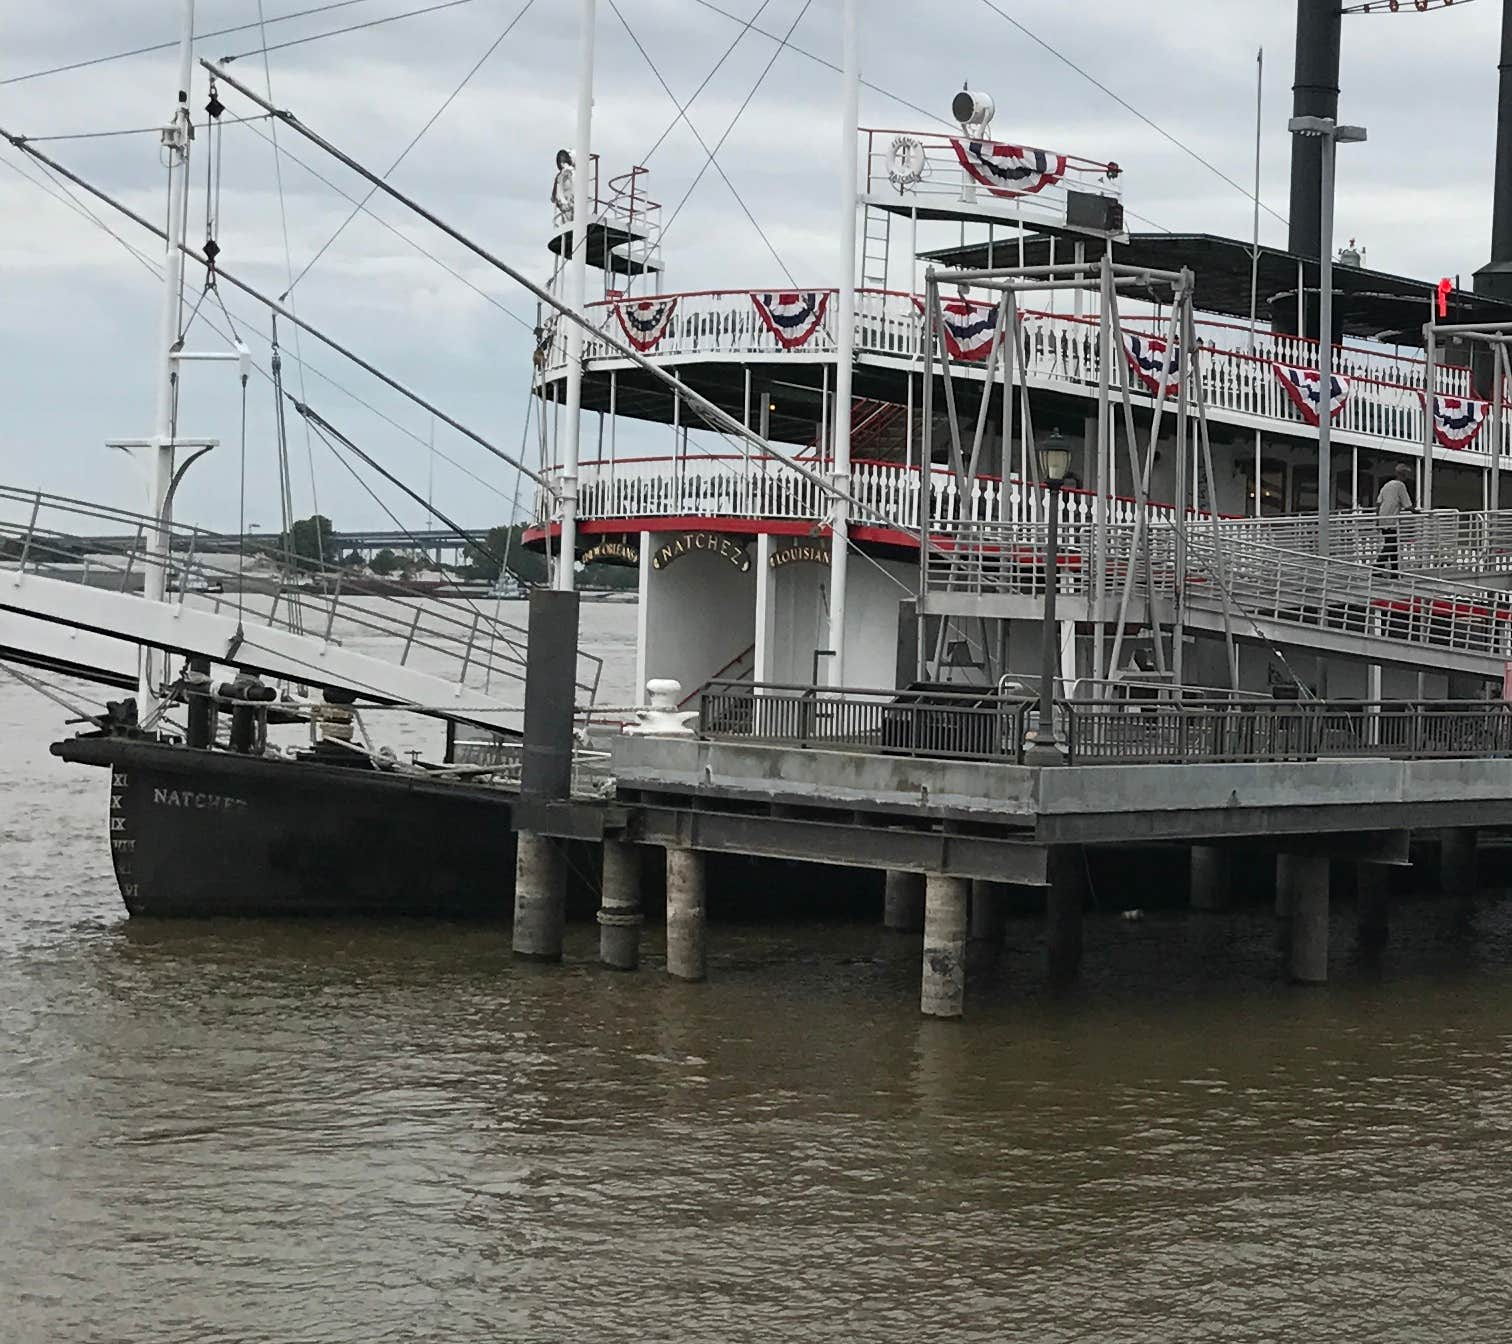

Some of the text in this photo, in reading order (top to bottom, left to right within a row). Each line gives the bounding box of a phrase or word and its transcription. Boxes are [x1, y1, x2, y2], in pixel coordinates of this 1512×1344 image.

[662, 533, 742, 566] NATCHEZ
[775, 546, 831, 564] LOUISIAN
[113, 773, 128, 787] XI
[111, 794, 122, 808] X
[110, 817, 126, 831] IX
